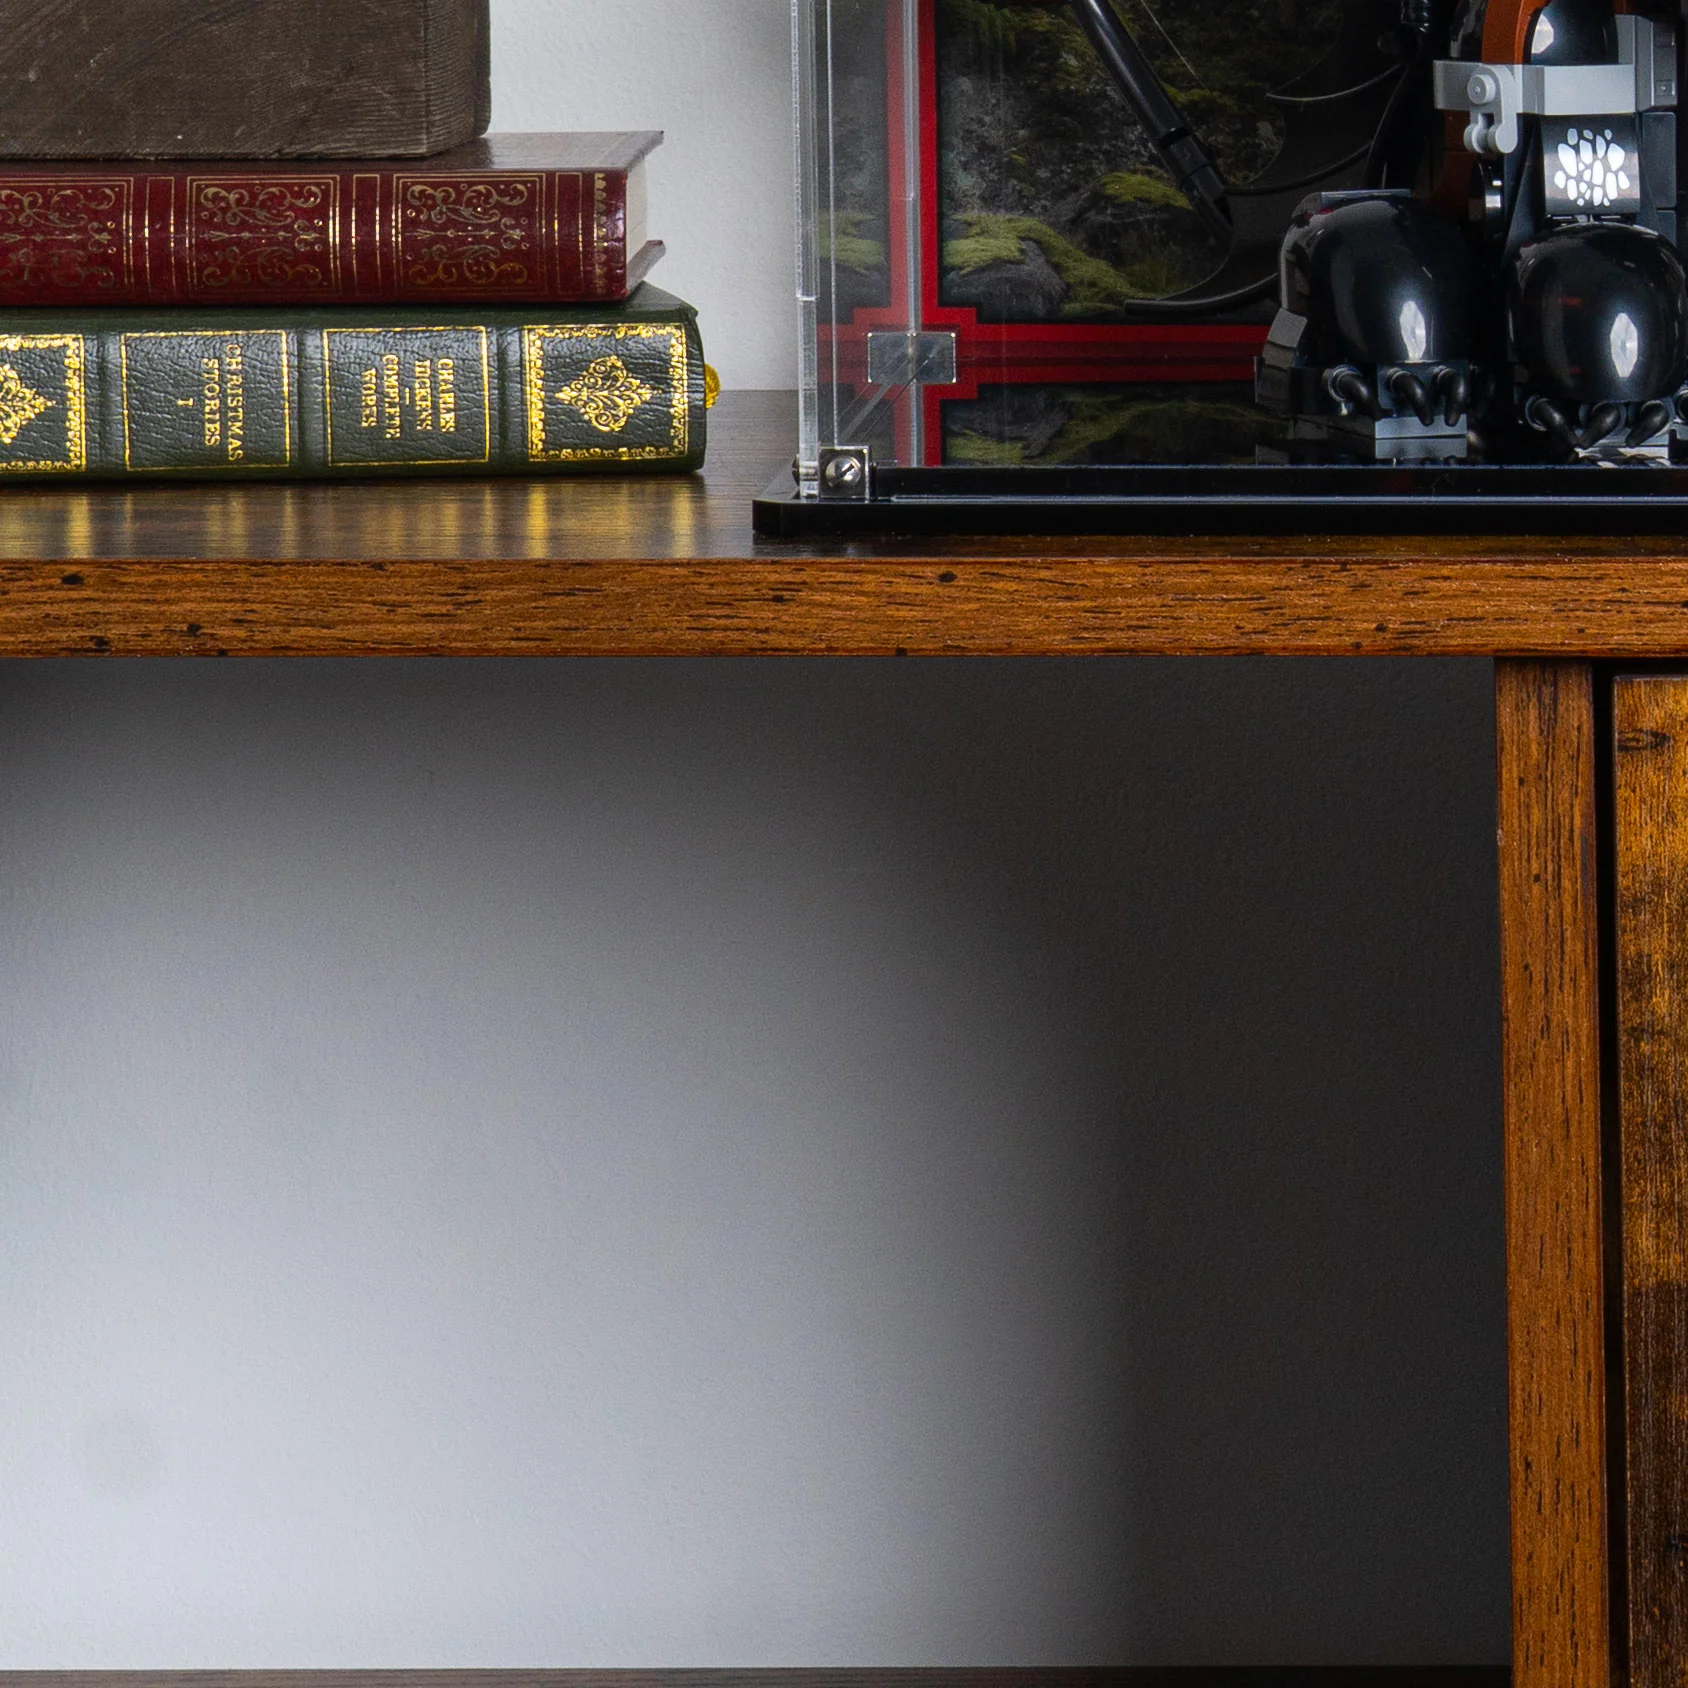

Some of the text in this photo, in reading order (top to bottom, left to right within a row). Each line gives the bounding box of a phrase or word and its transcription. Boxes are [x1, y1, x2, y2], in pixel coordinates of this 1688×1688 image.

[202, 358, 220, 447] STORIES
[226, 343, 244, 461] CHRISTMAS
[382, 354, 401, 439] COMPLETE
[415, 359, 433, 431] DICKENS
[438, 358, 456, 432] CHARLES
